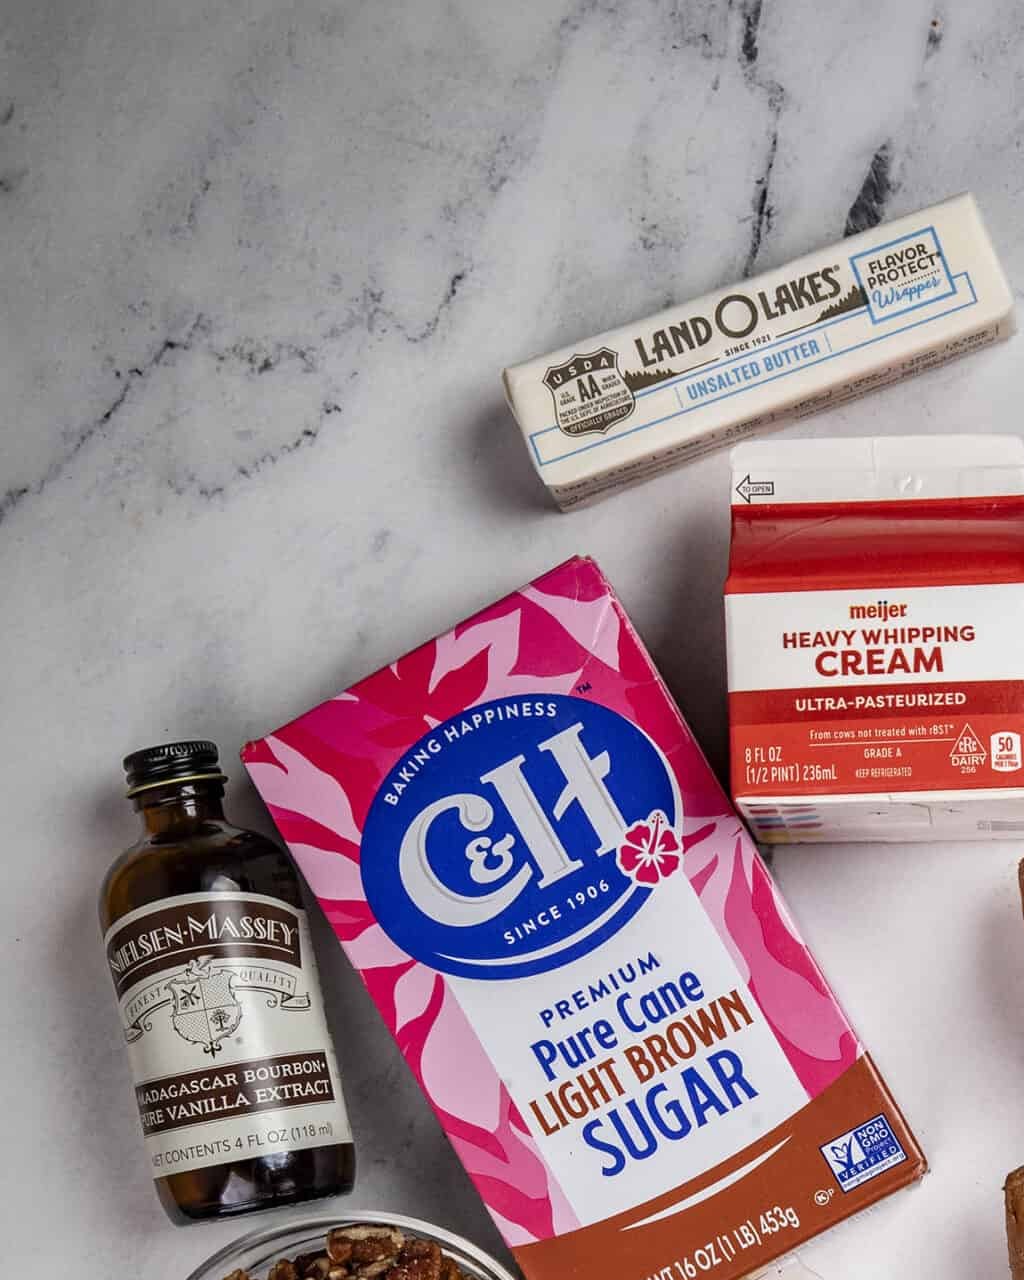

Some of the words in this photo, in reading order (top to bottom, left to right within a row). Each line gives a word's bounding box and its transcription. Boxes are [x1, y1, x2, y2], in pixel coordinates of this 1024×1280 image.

[867, 254, 936, 290] PROTECT
[868, 243, 928, 274] FLAVOR
[872, 276, 940, 308] Wrapper
[634, 317, 713, 367] LAND
[715, 294, 759, 338] O
[758, 267, 841, 320] LAKES
[724, 343, 750, 357] SINCE
[752, 334, 771, 350] 1921
[552, 357, 609, 384] USDA
[687, 361, 761, 400] UNSALTED
[765, 339, 821, 372] BUTTER
[577, 374, 602, 403] AA
[849, 601, 908, 622] meijer
[783, 630, 856, 649] HEAVY
[863, 625, 976, 646] WHIPPING
[815, 646, 944, 677] CREAM
[795, 692, 967, 712] ULTRA-PASTEURIZED
[810, 729, 832, 740] From
[834, 730, 855, 739] cows
[858, 728, 872, 738] not
[874, 726, 906, 737] treated
[908, 725, 927, 736] with
[998, 737, 1014, 753] 50
[383, 739, 442, 807] BAKING
[445, 701, 558, 742] HAPPINESS
[745, 747, 752, 763] 8
[755, 747, 766, 763] FL
[768, 746, 782, 762] OZ
[863, 747, 893, 759] GRADE
[895, 747, 903, 757] A
[951, 755, 986, 767] DAIRY
[746, 766, 769, 784] (1/2
[771, 763, 800, 783] PINT)
[803, 763, 838, 781] 236mL
[855, 768, 870, 778] KEEP
[870, 766, 912, 778] REFRIGERATED
[503, 904, 562, 945] SINCE
[566, 879, 610, 910] 1906
[239, 968, 293, 989] QUALITY
[539, 952, 662, 1028] PREMIUM
[531, 1018, 618, 1082] Pure
[616, 971, 705, 1033] Cane
[529, 1059, 627, 1137] LIGHT
[624, 989, 754, 1085] BROWN
[166, 1092, 250, 1122] VANILLA
[255, 1079, 330, 1104] EXTRACT
[582, 1048, 759, 1177] SUGAR
[166, 1139, 232, 1165] CONTENTS
[234, 1136, 243, 1149] 4
[248, 1134, 265, 1148] FL
[267, 1128, 289, 1144] OZ
[290, 1125, 317, 1142] (118
[857, 1120, 884, 1140] NON
[861, 1129, 888, 1148] GMO
[842, 1145, 897, 1179] VERIFIED
[674, 1257, 697, 1280] 16
[694, 1242, 722, 1271] OZ
[717, 1234, 737, 1262] (1
[733, 1219, 763, 1250] LB)
[759, 1206, 801, 1236] 453g
